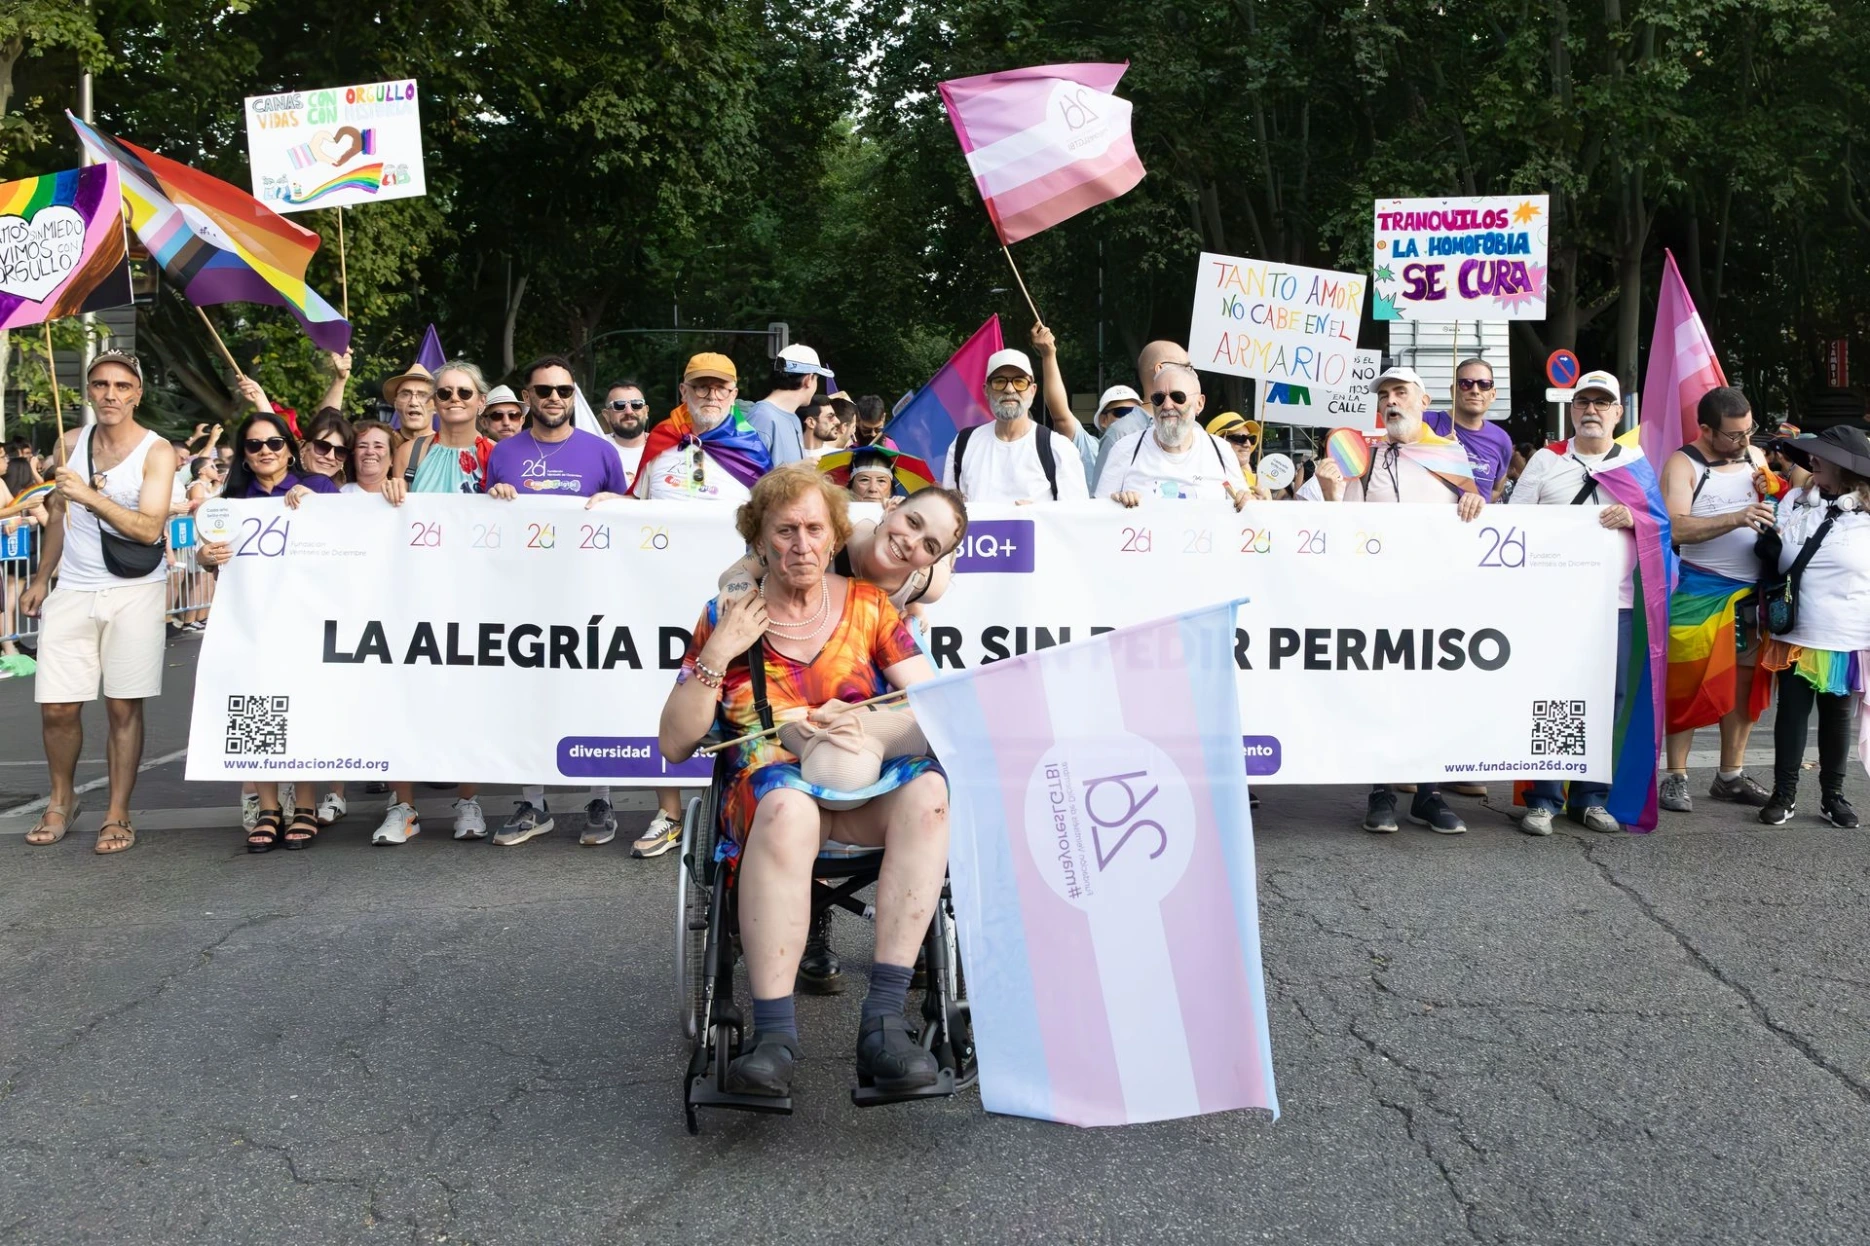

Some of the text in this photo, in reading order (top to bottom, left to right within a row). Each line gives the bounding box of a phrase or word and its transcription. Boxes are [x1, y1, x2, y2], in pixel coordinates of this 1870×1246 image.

[252, 83, 415, 112] CANAS CON ORGULLO
[256, 111, 300, 130] VIDAS
[307, 106, 338, 124] CON
[1377, 208, 1509, 231] TRANQUILOS
[0, 223, 28, 243] MOS
[43, 220, 83, 239] MIEDO
[58, 241, 78, 253] CON
[1392, 232, 1531, 258] LA HOMOFOBIA
[1213, 262, 1362, 316] TANTO AMOR
[1402, 258, 1534, 301] SE CURA
[1222, 294, 1352, 341] NO CABE EN EL
[1213, 332, 1346, 385] ARMARIO
[1352, 367, 1375, 380] NO
[1328, 401, 1367, 414] CALLE
[1348, 394, 1360, 402] LA
[322, 619, 393, 664] LA
[403, 614, 643, 669] ALEGRÍA
[658, 626, 694, 670] D
[980, 626, 1071, 667] SIN
[1269, 628, 1511, 671] PERMISO
[569, 745, 651, 759] diversidad
[224, 758, 389, 771] www.fundacion26d.org
[1444, 760, 1588, 774] www.fundacion26d.org
